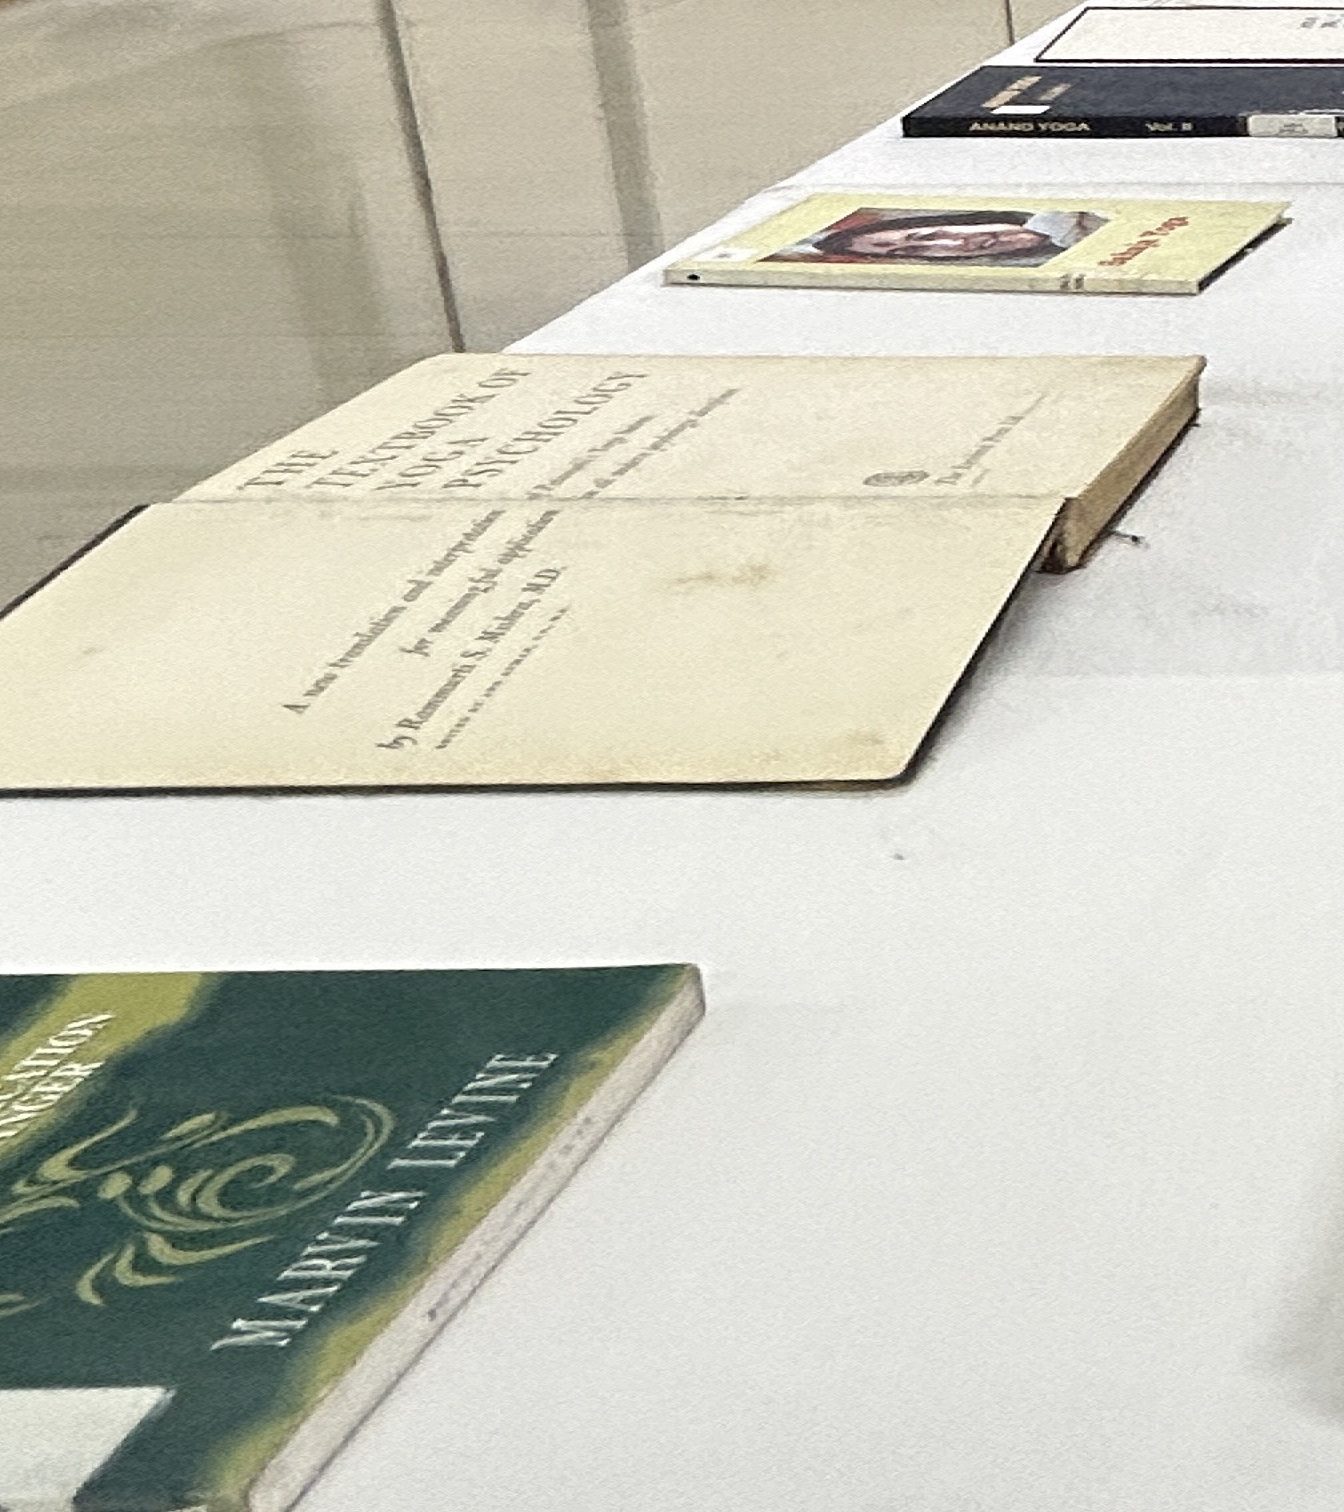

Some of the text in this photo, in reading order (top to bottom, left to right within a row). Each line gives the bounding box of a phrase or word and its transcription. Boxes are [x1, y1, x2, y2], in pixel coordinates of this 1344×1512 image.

[1038, 121, 1091, 133] YOGA
[237, 449, 340, 490] THE
[305, 367, 532, 488] TEXTBOOK OF
[375, 436, 489, 490] YOGA
[443, 372, 649, 489] PSYCHOLOGY
[428, 567, 503, 634] meaningful
[497, 509, 563, 566] application
[282, 703, 311, 715] A
[328, 605, 408, 668] translation
[402, 579, 434, 603] and
[375, 734, 418, 750] by
[211, 1050, 560, 1351] MARVIN LEVINE
